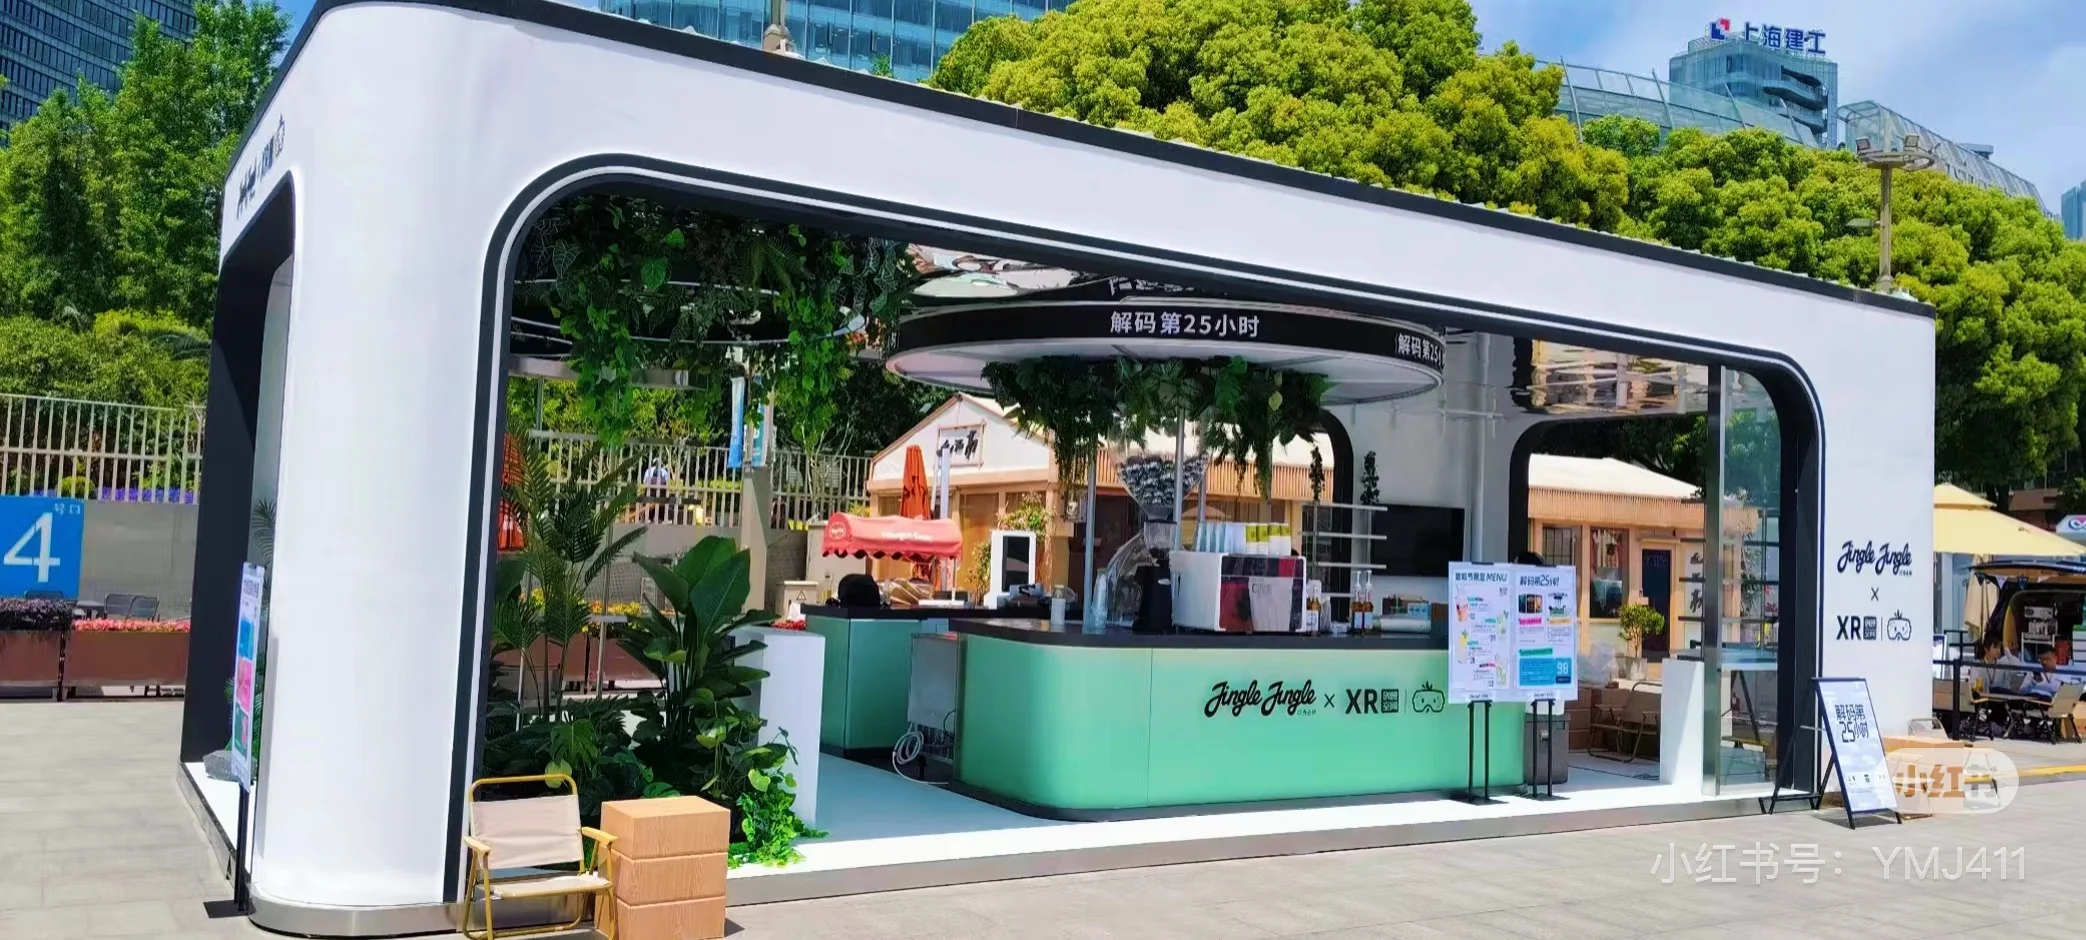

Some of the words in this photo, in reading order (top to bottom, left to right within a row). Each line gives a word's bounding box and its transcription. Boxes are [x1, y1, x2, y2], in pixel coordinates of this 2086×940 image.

[1745, 22, 1826, 55] 上海建工
[1110, 310, 1259, 337] 解码第25小时
[3, 512, 61, 583] 4
[1837, 540, 1875, 574] Jingle
[1486, 572, 1508, 582] MENU
[1836, 615, 1862, 640] XR
[1204, 679, 1262, 717] Jingle
[1345, 688, 1378, 714] XR
[1835, 704, 1866, 721] 解码第
[1839, 721, 1870, 743] 25小时
